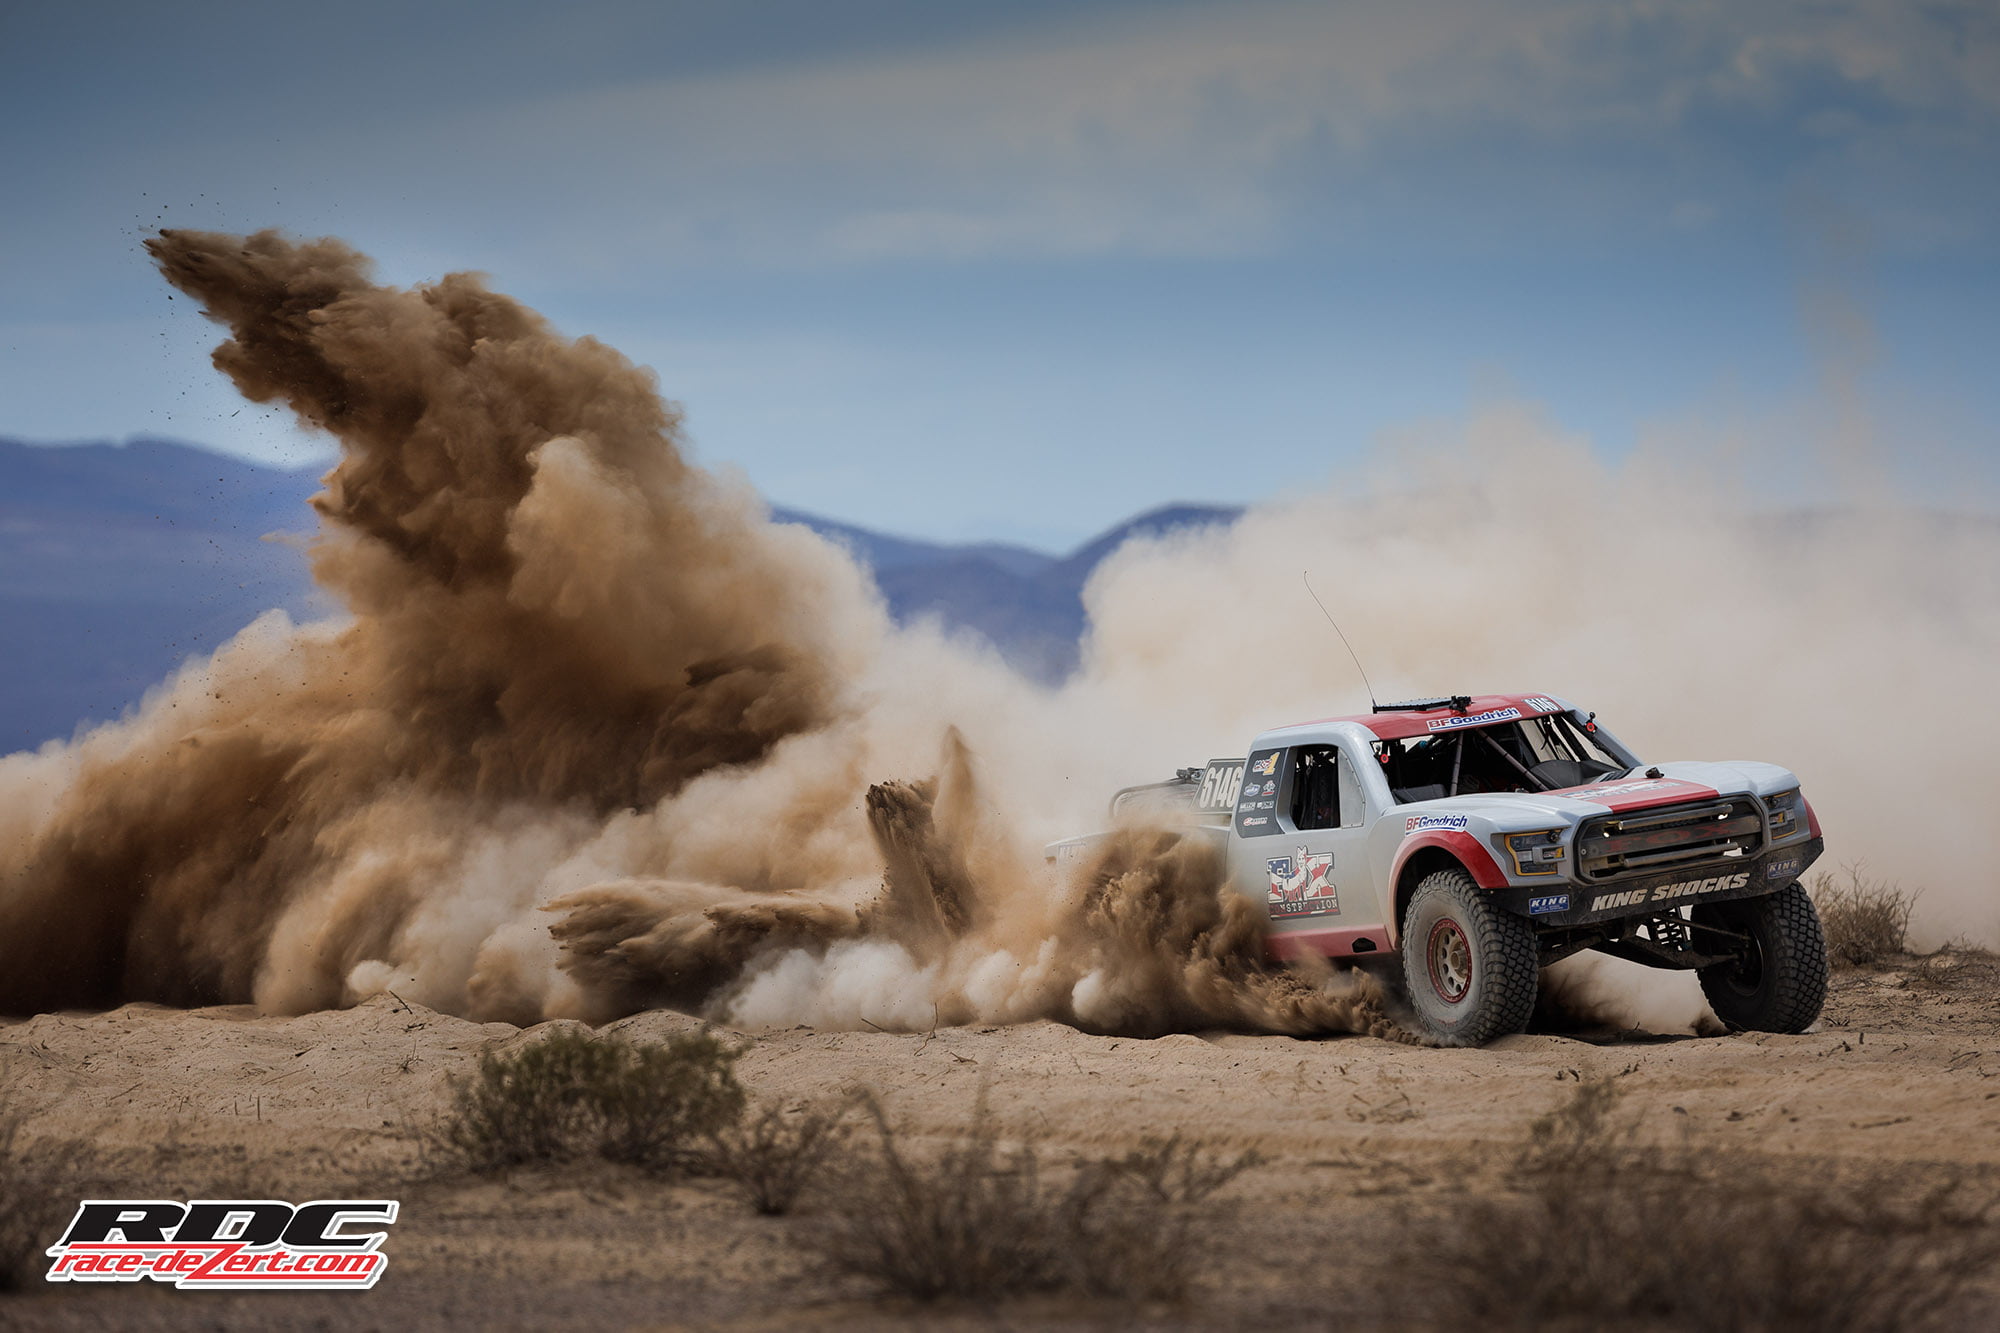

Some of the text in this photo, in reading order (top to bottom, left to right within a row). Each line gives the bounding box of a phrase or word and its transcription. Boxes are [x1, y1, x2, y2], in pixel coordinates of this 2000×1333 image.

[1428, 707, 1519, 728] BFGoodrich
[1200, 766, 1243, 809] 6146
[1406, 815, 1468, 831] BFGoodrich
[1604, 821, 1739, 851] FOX
[1769, 860, 1797, 872] KING
[1531, 896, 1567, 907] KING
[1591, 873, 1750, 912] KING SHOCKS
